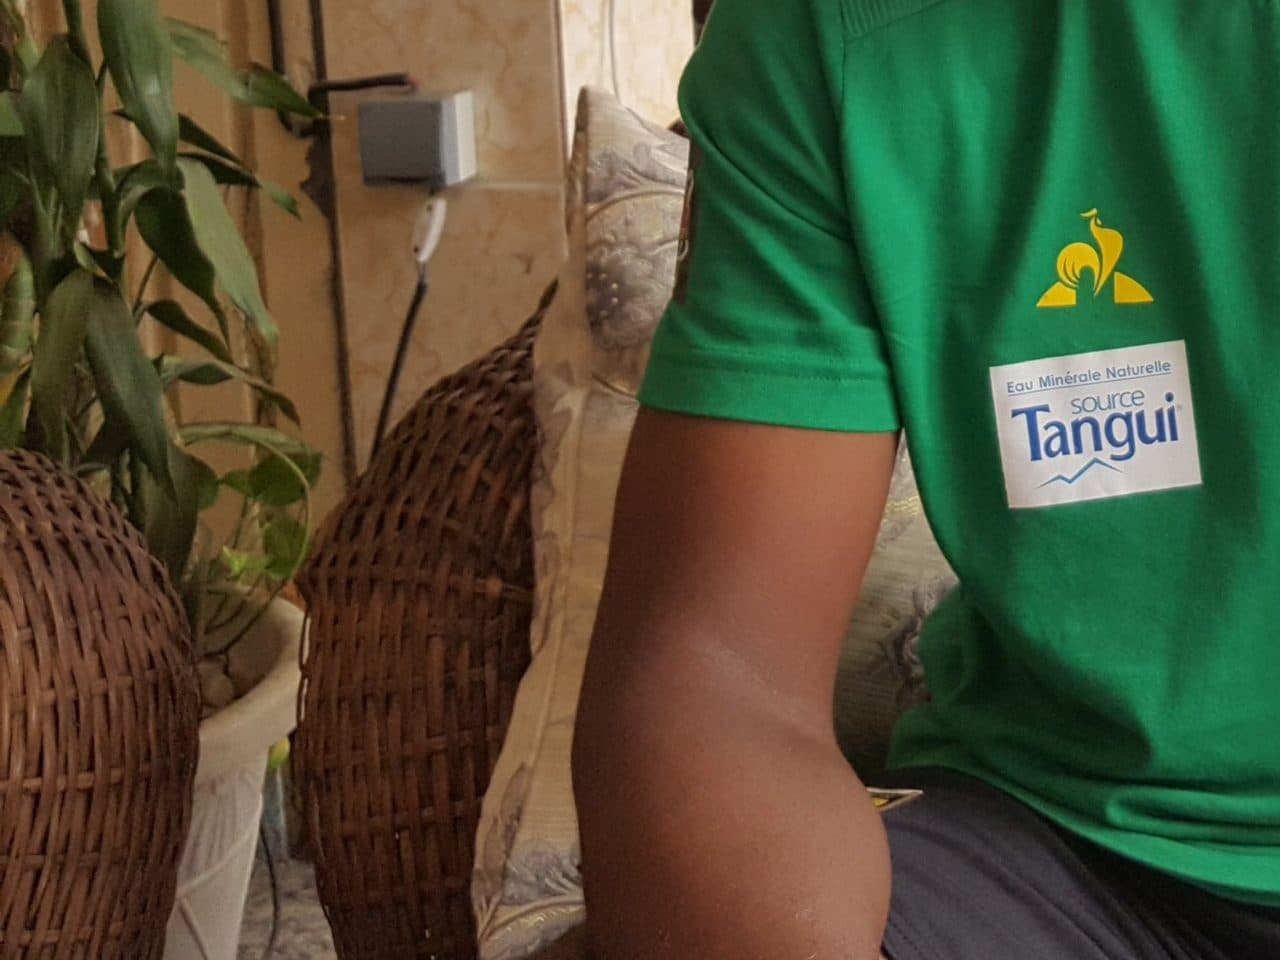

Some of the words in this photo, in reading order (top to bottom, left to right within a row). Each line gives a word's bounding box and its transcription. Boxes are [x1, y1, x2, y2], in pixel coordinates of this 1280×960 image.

[1006, 381, 1033, 394] Eau
[1039, 369, 1101, 389] Minérale
[1106, 359, 1172, 379] Naturelle
[1071, 389, 1145, 415] source
[1010, 391, 1180, 462] Tangui
